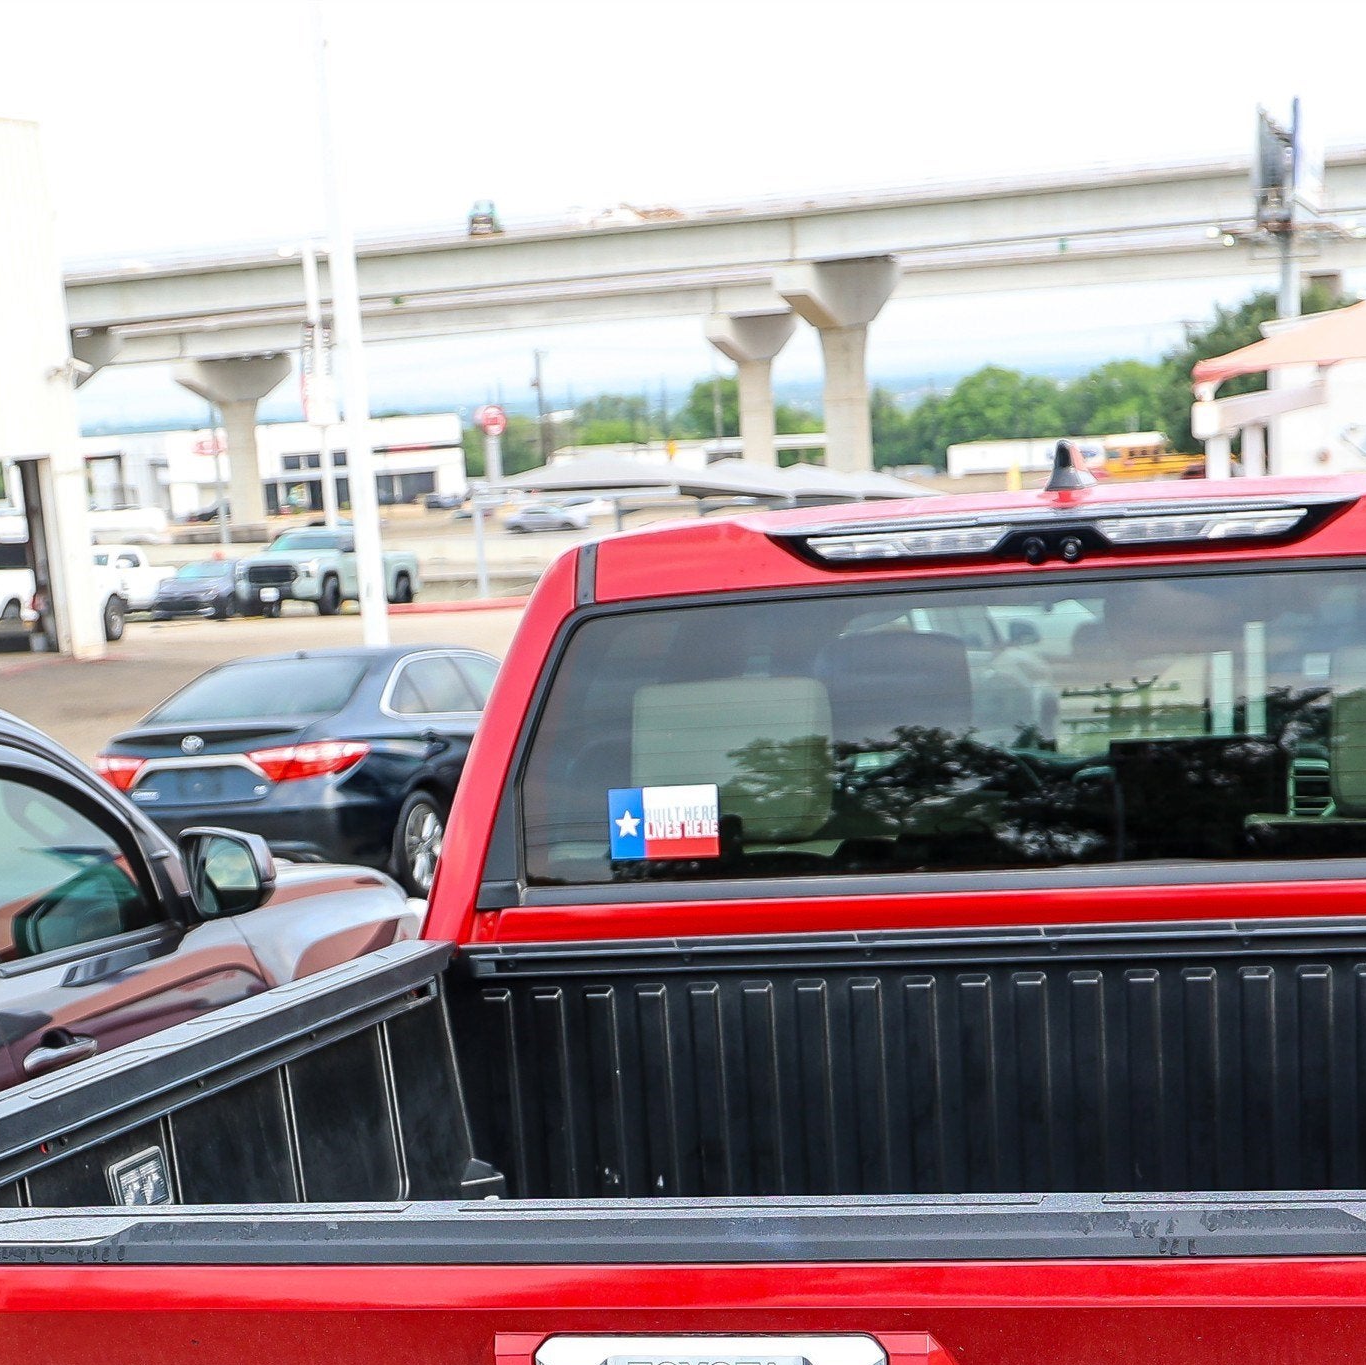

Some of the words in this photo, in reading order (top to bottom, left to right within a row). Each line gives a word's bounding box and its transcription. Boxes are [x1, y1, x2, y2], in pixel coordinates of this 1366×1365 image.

[645, 806, 681, 822] BUILT
[684, 804, 718, 820] HERE
[645, 821, 682, 839] LIVES
[684, 819, 718, 838] HERE
